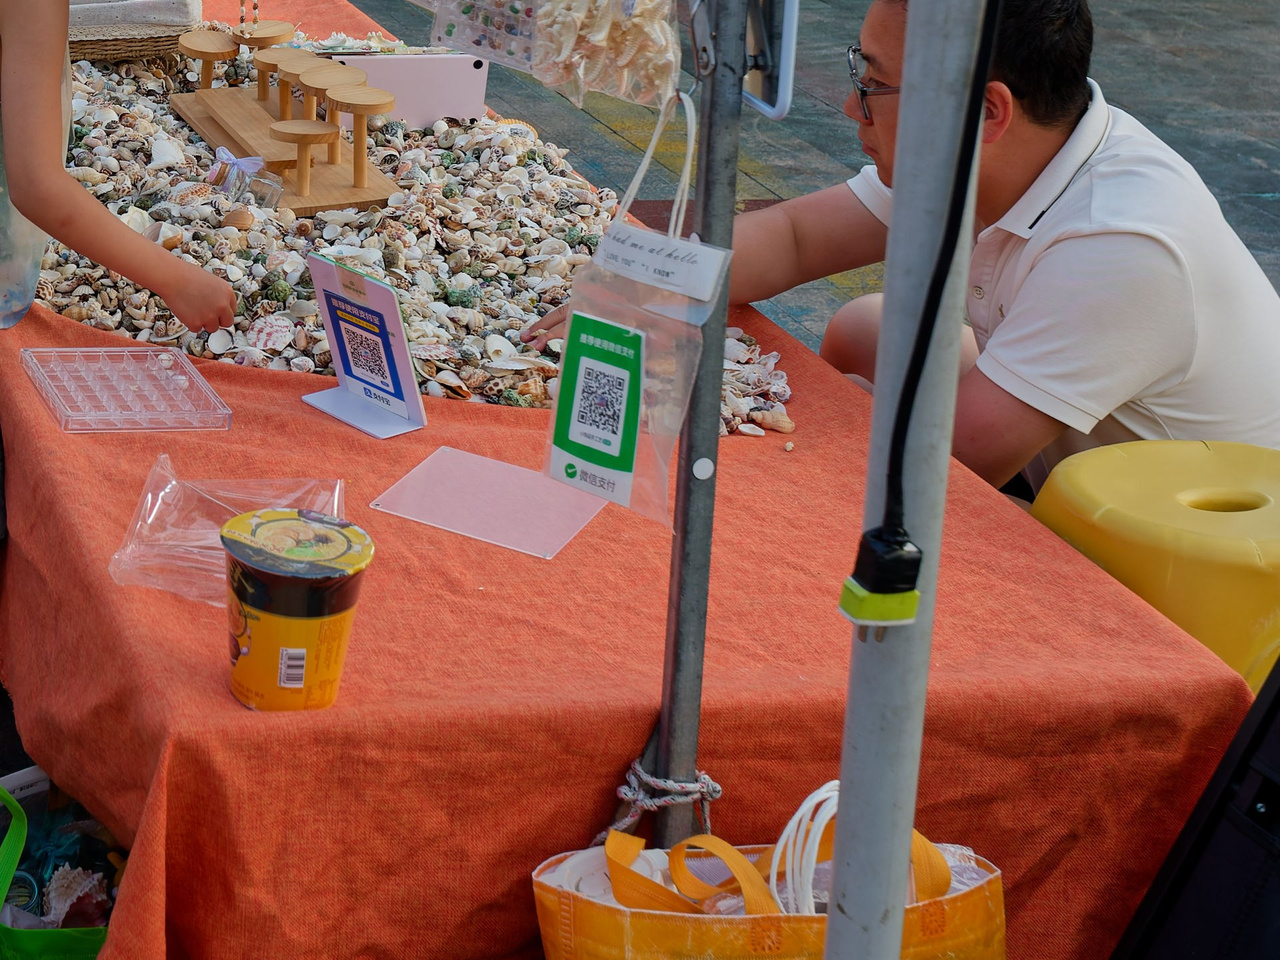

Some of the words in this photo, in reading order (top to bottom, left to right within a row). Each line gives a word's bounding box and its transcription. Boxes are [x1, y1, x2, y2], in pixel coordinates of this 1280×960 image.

[612, 234, 631, 245] had
[630, 241, 644, 251] me
[648, 247, 664, 256] at
[665, 247, 699, 265] hello
[373, 393, 391, 407] 支付宝
[579, 469, 616, 493] 微信支付
